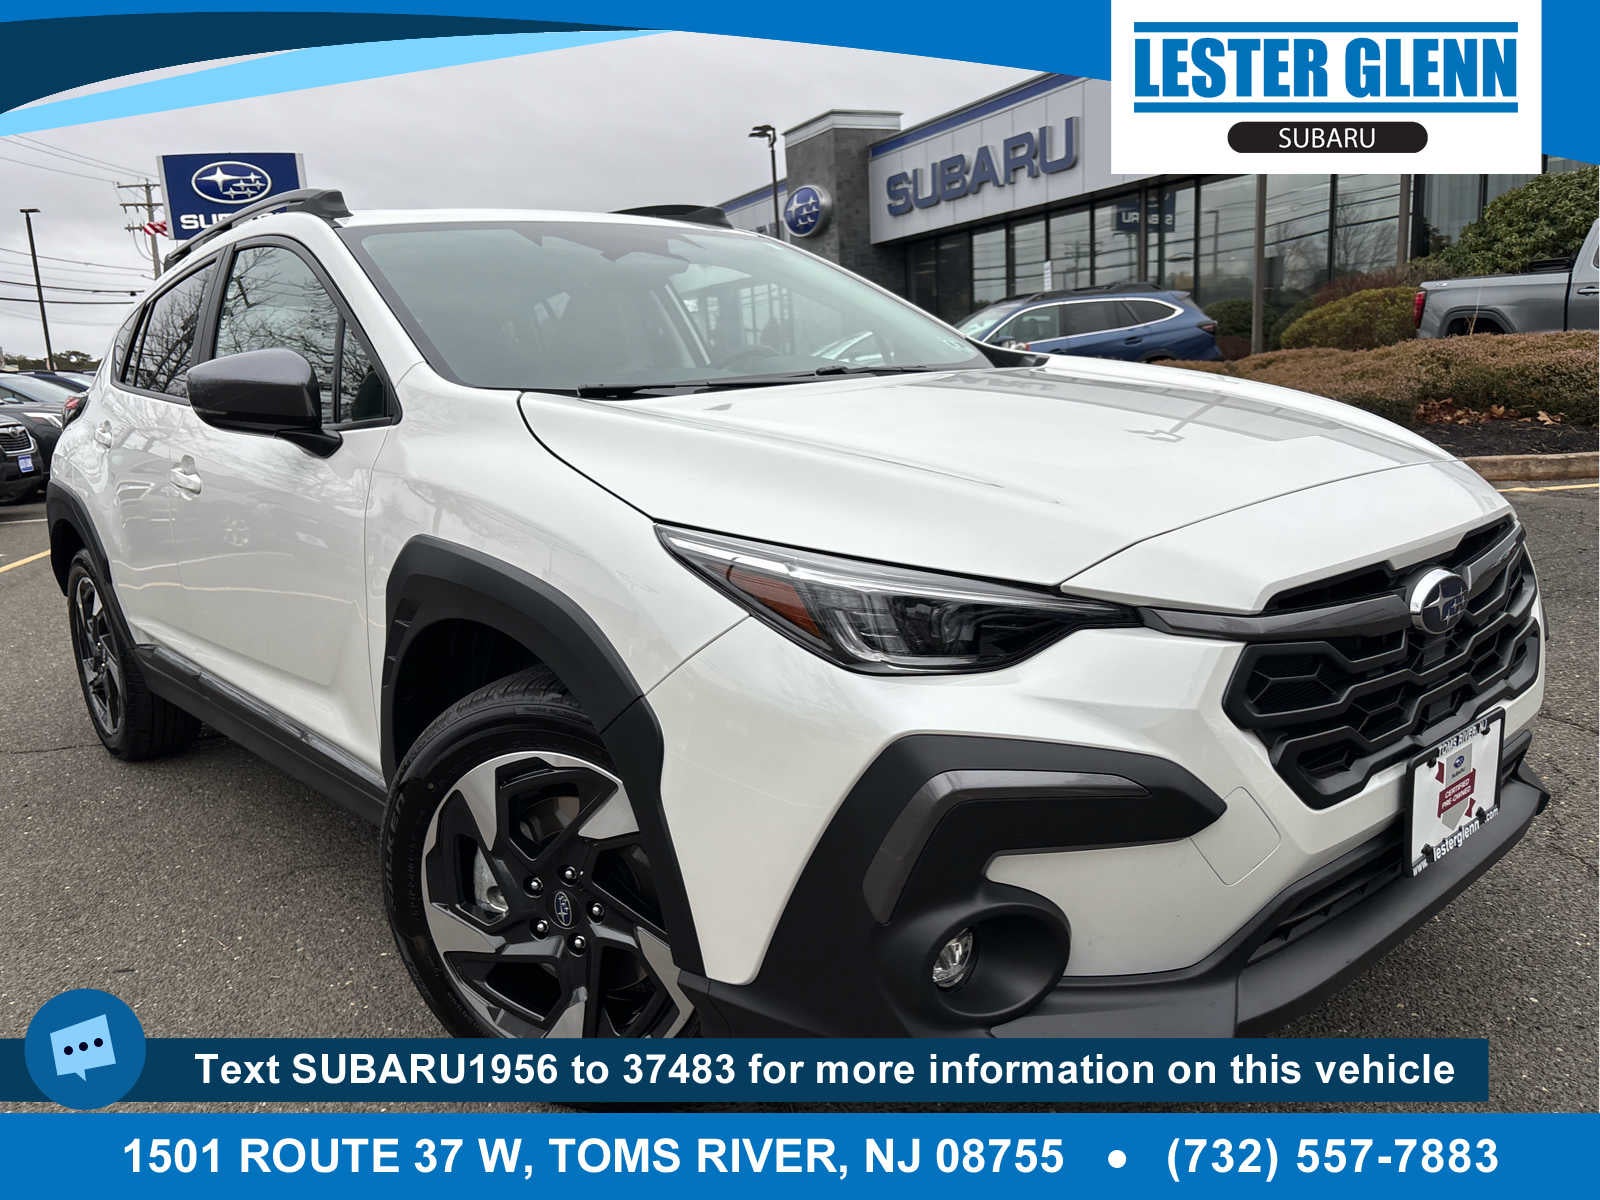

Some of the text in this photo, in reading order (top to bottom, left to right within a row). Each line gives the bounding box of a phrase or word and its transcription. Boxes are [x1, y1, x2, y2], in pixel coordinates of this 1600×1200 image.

[887, 117, 1080, 217] SUBARU
[1441, 785, 1471, 810] PRE-OWNED
[1445, 778, 1470, 799] CERTIFIED
